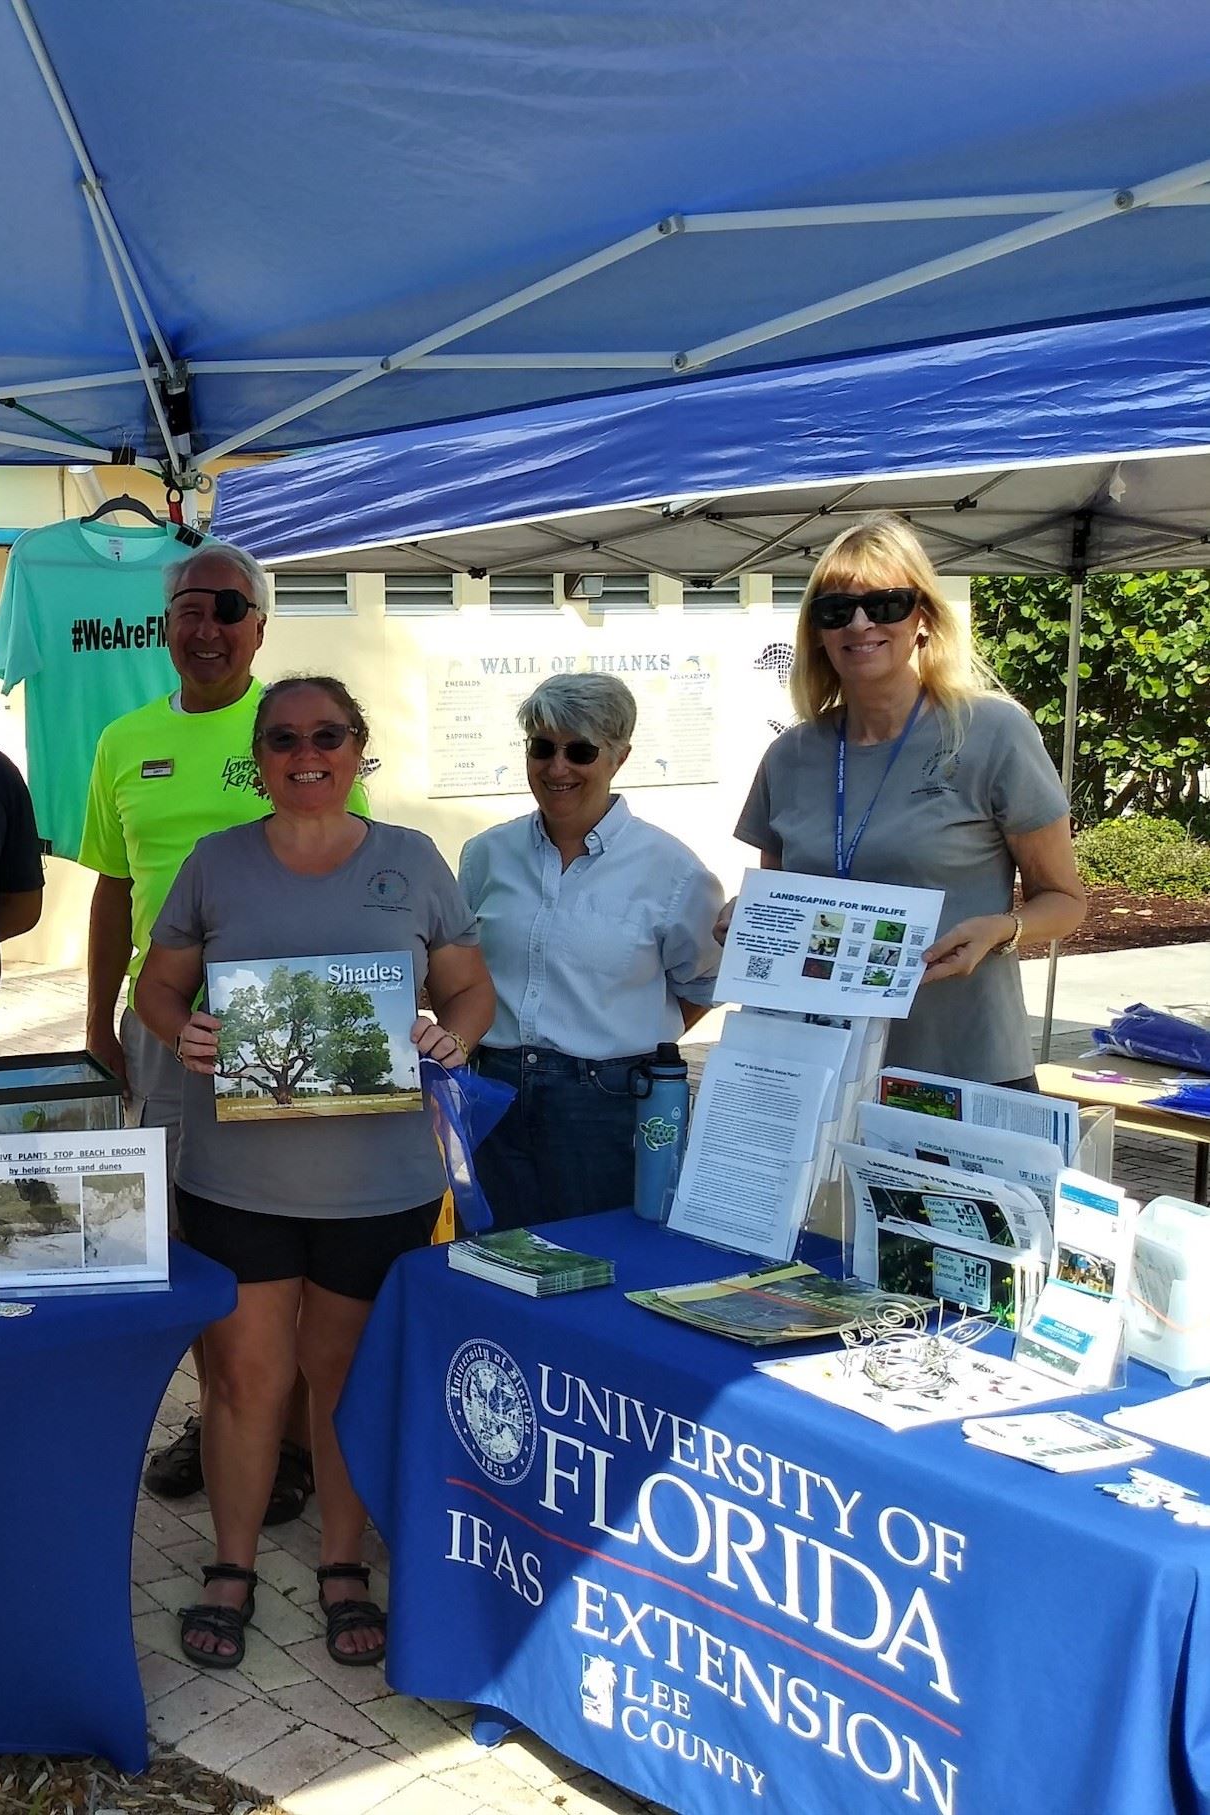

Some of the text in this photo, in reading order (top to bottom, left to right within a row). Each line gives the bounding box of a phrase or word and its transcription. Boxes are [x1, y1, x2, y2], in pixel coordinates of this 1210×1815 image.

[71, 615, 170, 652] #WeAreFM
[480, 654, 671, 675] WALL OF THANKS
[770, 891, 907, 917] LANDSCAPING FOR WILDLIFE
[327, 961, 403, 985] Shades
[18, 1152, 48, 1160] PLANTS
[53, 1150, 74, 1159] STOP
[79, 1149, 105, 1158] BEACH
[111, 1147, 146, 1156] EROSION
[918, 1140, 1004, 1166] FLORIDA BUTTERFLY GARDEN
[9, 1162, 122, 1175] by helping form sand dunes
[867, 1160, 932, 1181] LANDSCAPING
[931, 1175, 950, 1185] FOR
[1019, 1170, 1052, 1183] UF IFAS
[450, 1345, 532, 1435] University of Florida
[480, 1454, 506, 1478] 1853
[538, 1362, 966, 1584] UNIVERSITY OF
[445, 1508, 545, 1607] IFAS
[538, 1426, 961, 1705] FLORIDA
[570, 1575, 960, 1815] EXTENSION
[621, 1664, 692, 1721] LEE
[620, 1703, 767, 1798] COUNTY
